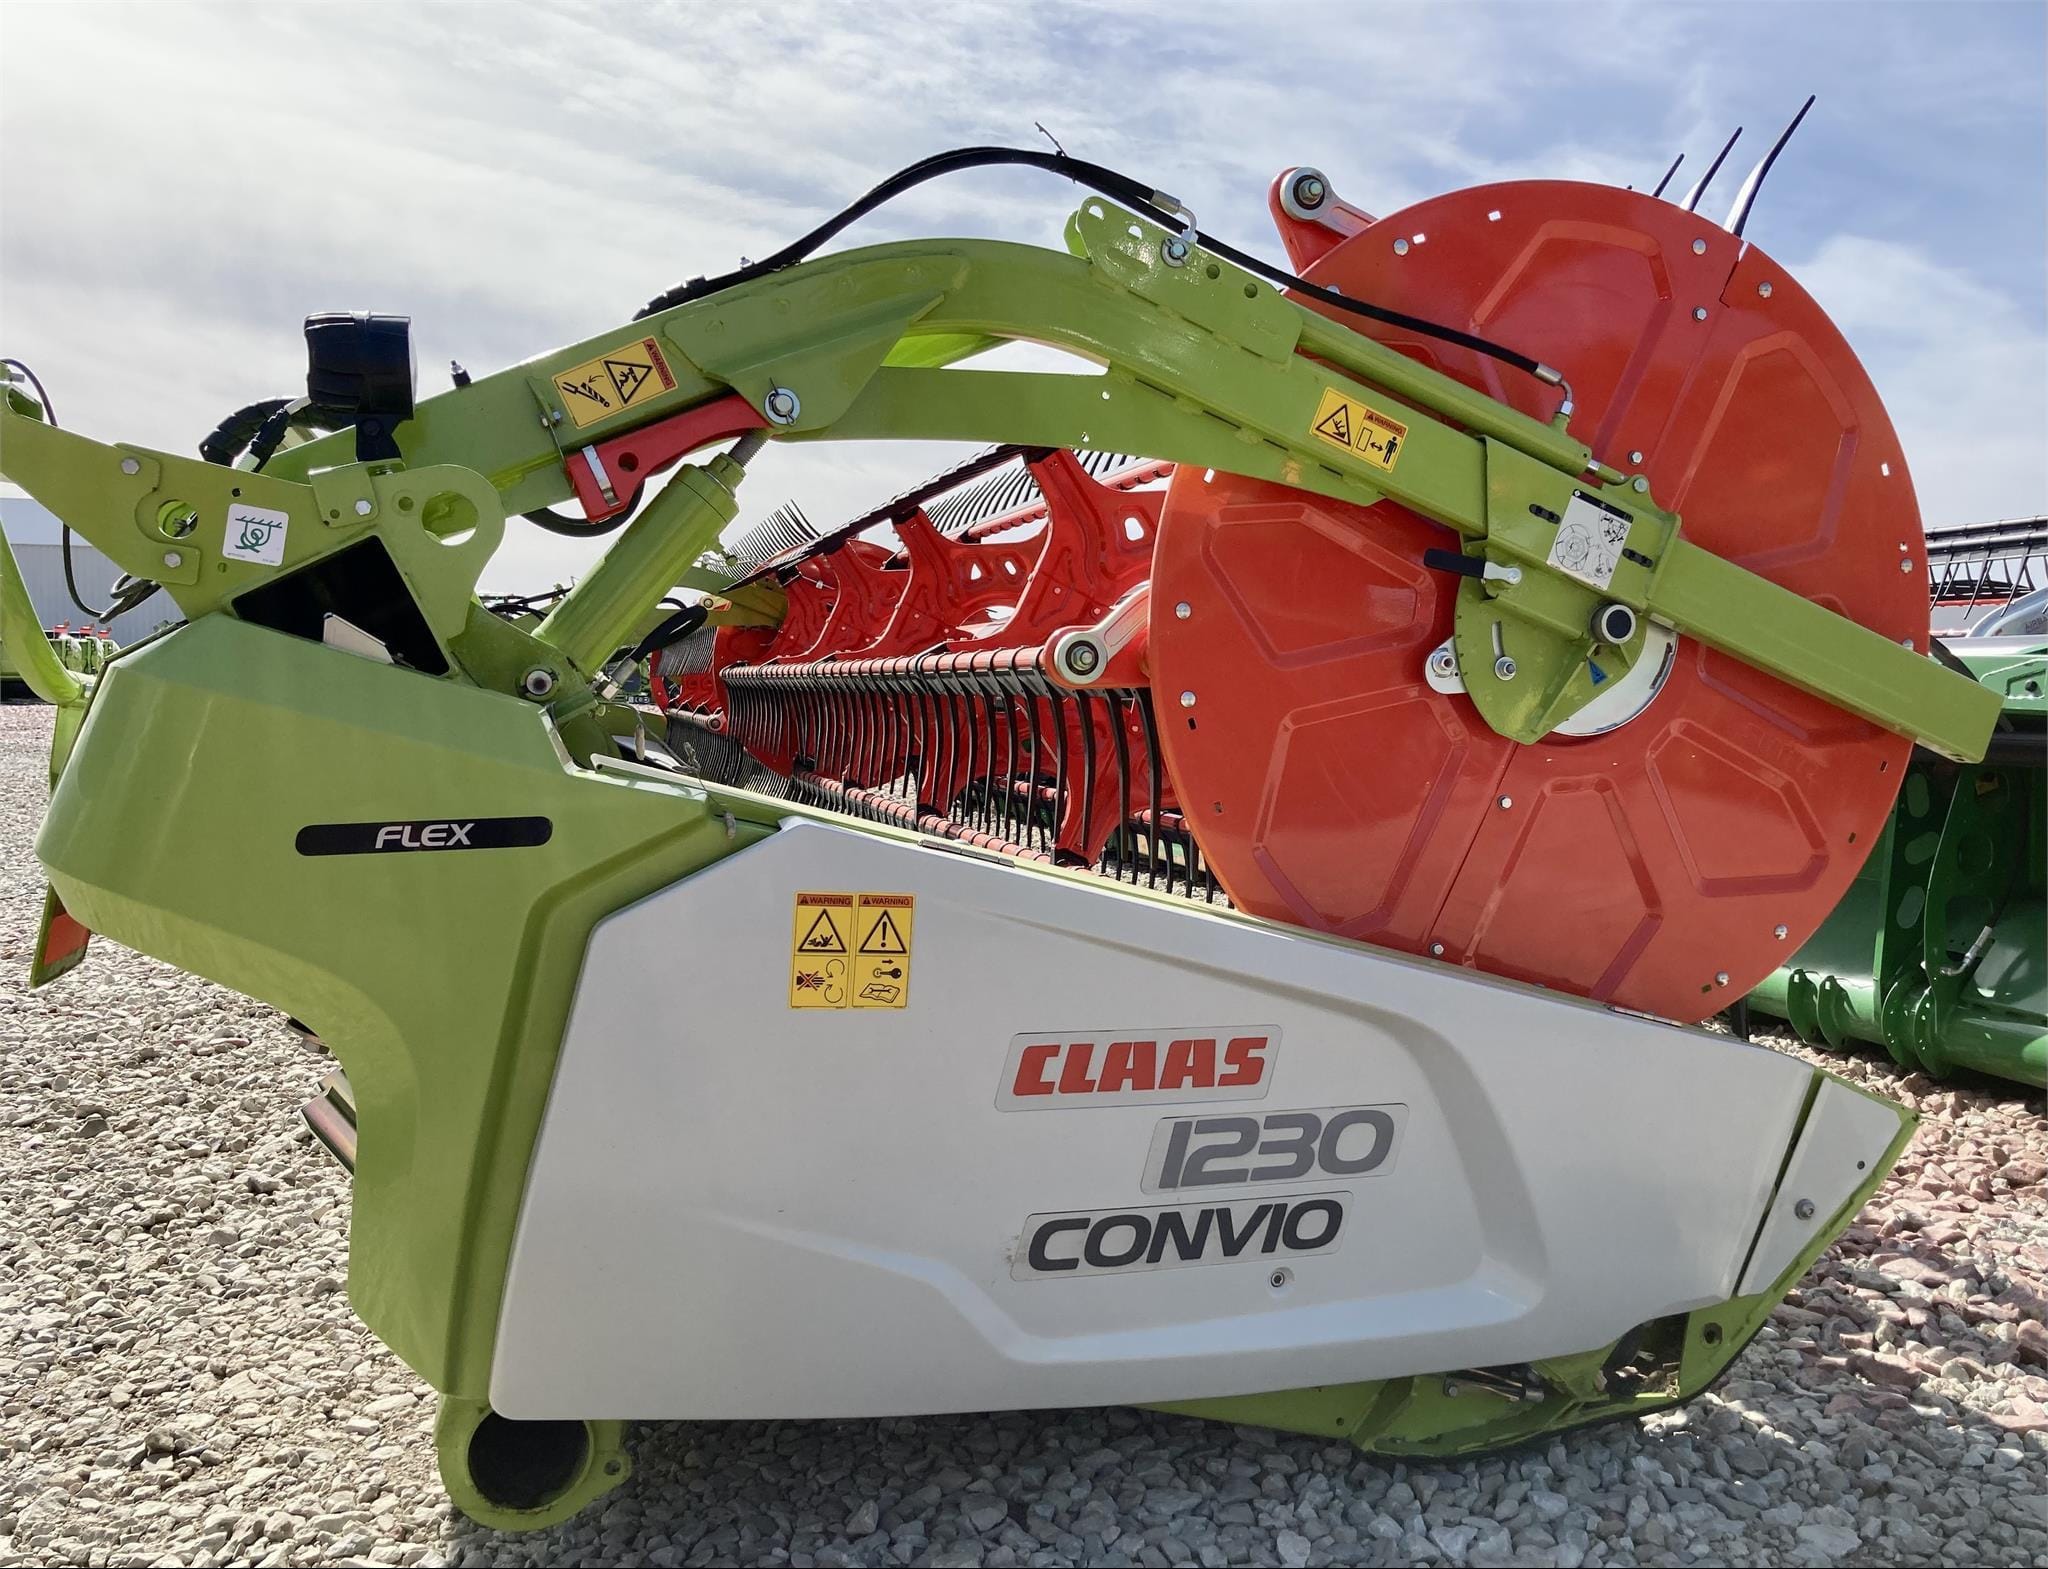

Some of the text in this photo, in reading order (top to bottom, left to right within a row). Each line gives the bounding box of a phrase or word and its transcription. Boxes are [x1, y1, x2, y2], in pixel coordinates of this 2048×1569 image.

[650, 349, 671, 386] WARNING
[1374, 416, 1403, 435] WARNING
[375, 823, 475, 849] FLEX
[809, 898, 851, 906] WARNING
[871, 898, 910, 906] WARNING
[1012, 1036, 1268, 1096] CLAAS
[1158, 1109, 1394, 1189] 1230
[1028, 1198, 1344, 1272] CONVIO
